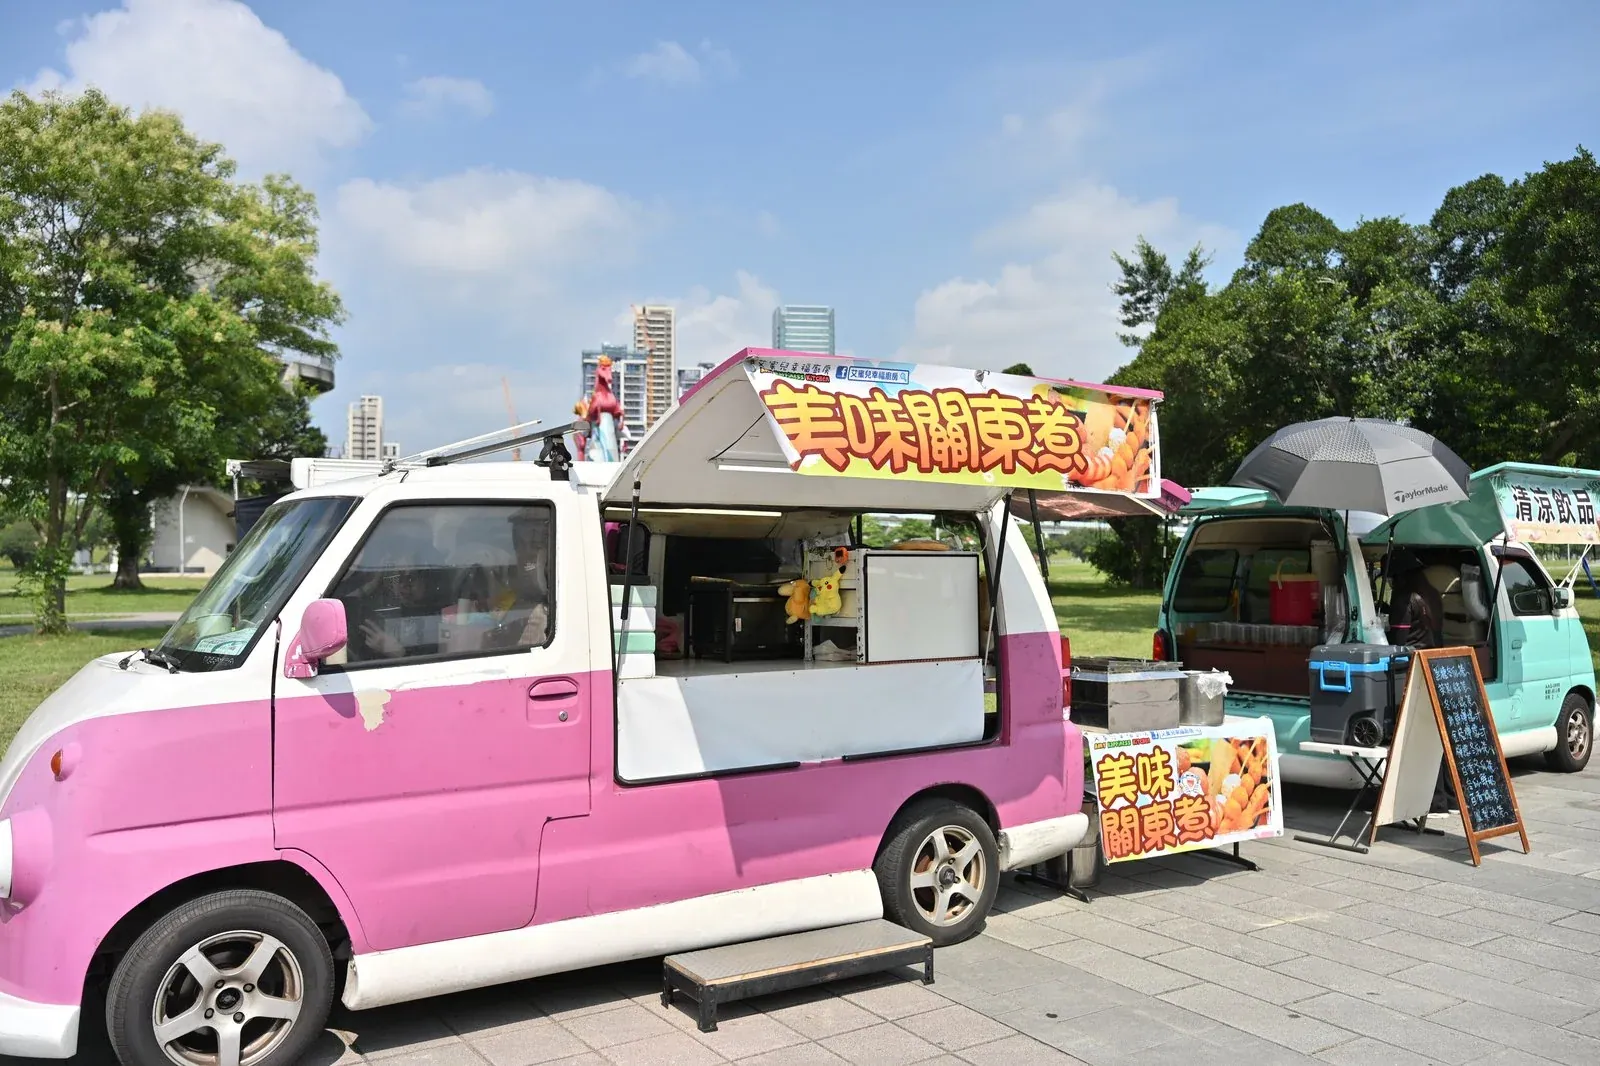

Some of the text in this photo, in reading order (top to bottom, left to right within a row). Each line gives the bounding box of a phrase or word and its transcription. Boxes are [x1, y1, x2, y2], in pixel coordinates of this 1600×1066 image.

[759, 379, 1087, 474] 美味關東煮
[1393, 483, 1449, 503] TaylorMade
[1512, 485, 1596, 525] 清涼飲品
[1096, 745, 1175, 810] 美味
[1100, 795, 1217, 860] 關東煮
